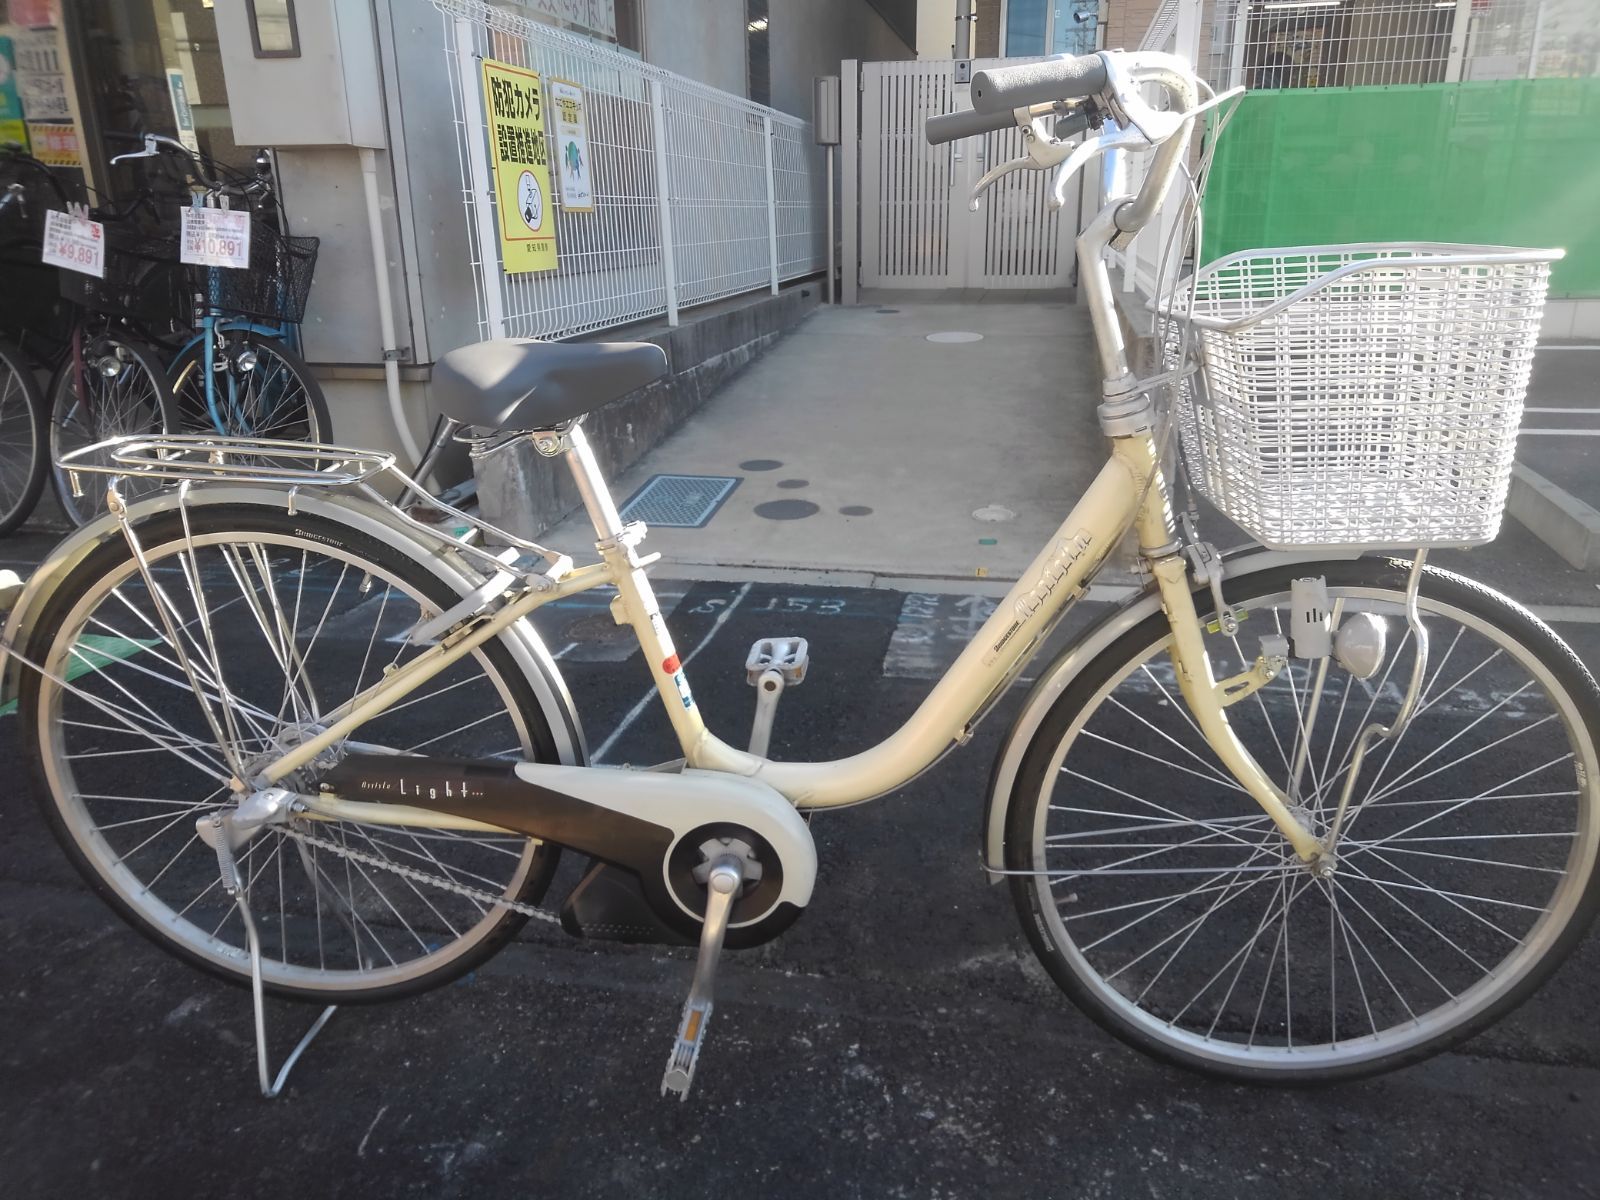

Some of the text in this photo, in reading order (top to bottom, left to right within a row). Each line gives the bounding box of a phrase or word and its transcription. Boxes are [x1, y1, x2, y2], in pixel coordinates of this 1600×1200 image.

[491, 77, 540, 121] 防犯カメラ
[59, 242, 99, 266] ¥9,891
[194, 238, 242, 257] ¥10,891
